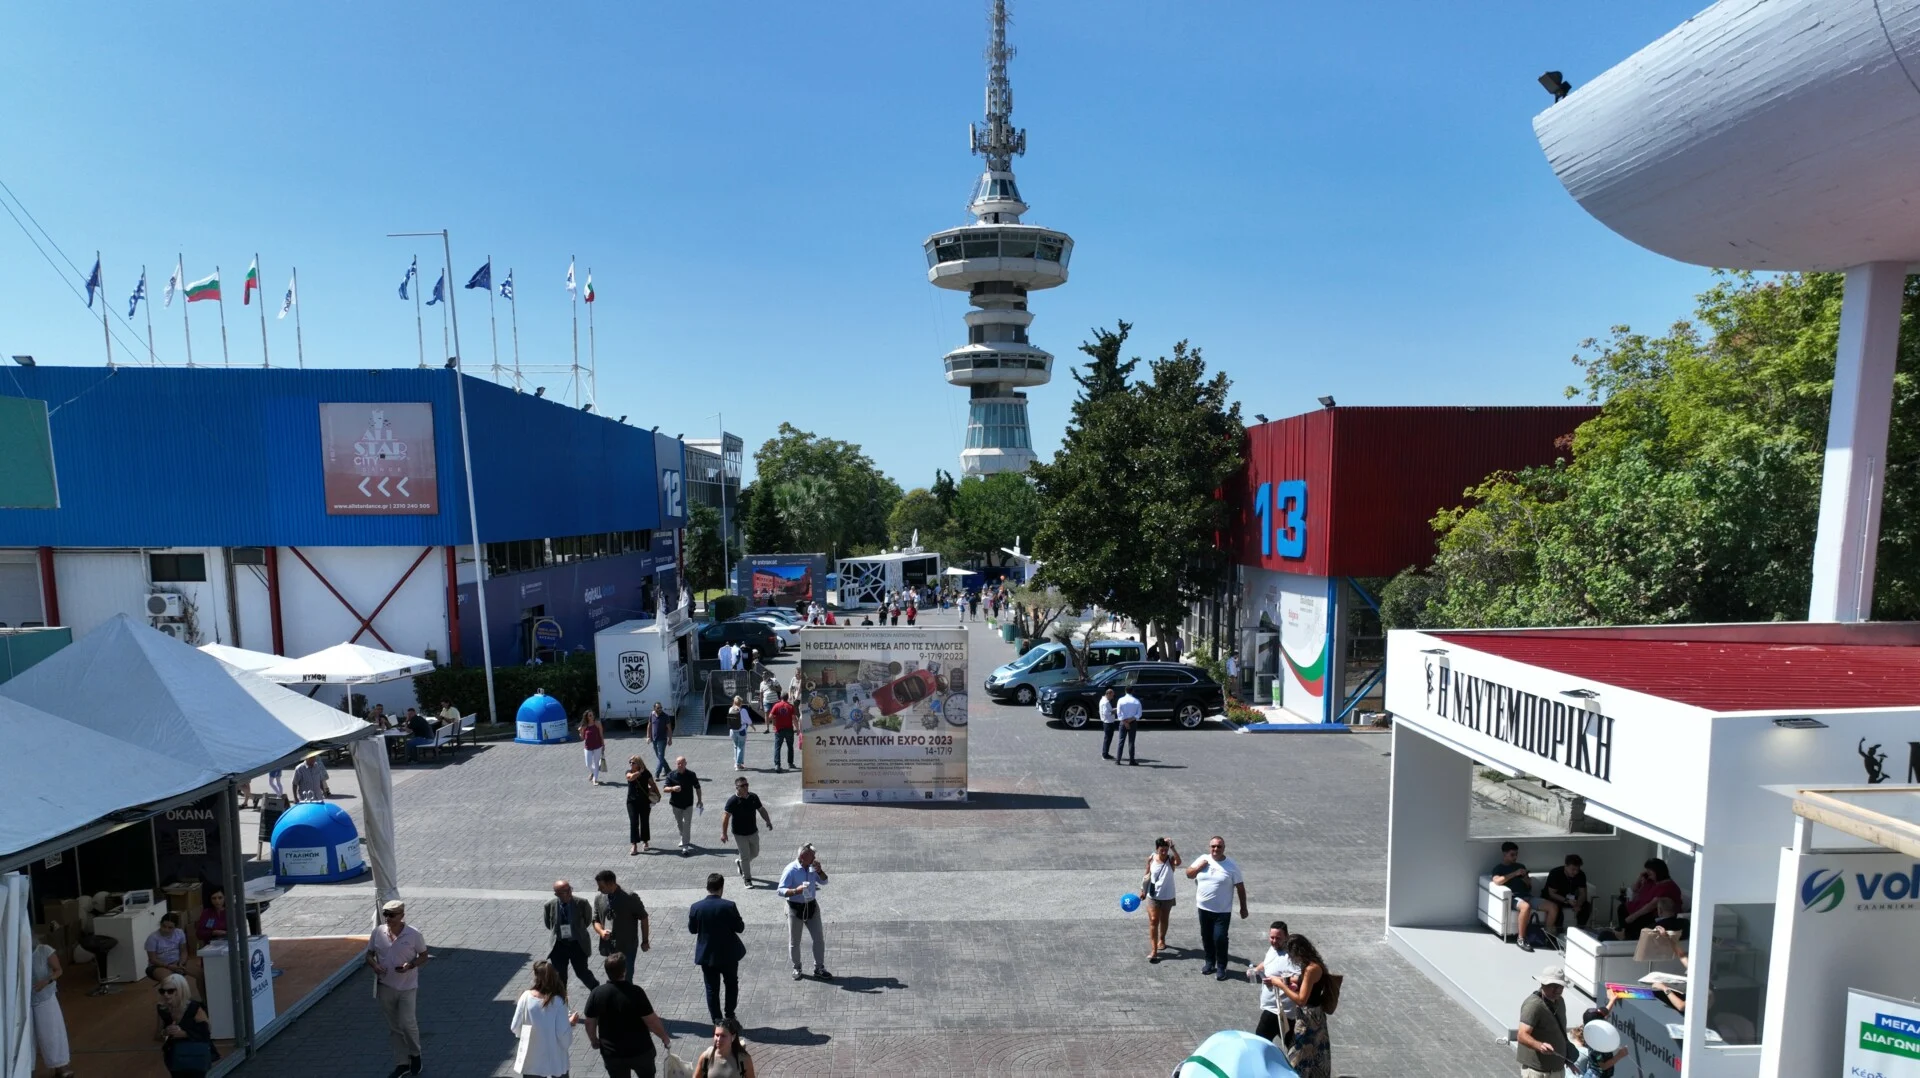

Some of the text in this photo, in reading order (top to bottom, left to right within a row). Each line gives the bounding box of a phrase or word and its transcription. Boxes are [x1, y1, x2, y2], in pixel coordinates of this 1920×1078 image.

[361, 430, 398, 441] ALL
[354, 442, 408, 460] STAR
[353, 457, 379, 466] CITY
[663, 471, 682, 517] 12
[1254, 479, 1307, 559] 13
[813, 643, 868, 651] ΘΕΣΣΑΛΟΝΙΚΗ
[870, 643, 891, 651] ΜΕΣΑ
[893, 643, 911, 651] ΑΠΟ
[912, 643, 924, 651] ΤΙΣ
[925, 643, 964, 651] ΣΥΛΛΟΓΕΣ
[621, 655, 645, 664] ΠΑΟΚ
[1437, 665, 1616, 784] Η ΝΑΥΤΕΜΠΟΡΙΚΗ
[815, 735, 953, 747] 2η ΣΥΛΛΕΚΤΙΚΗ EXPO 2023
[1857, 903, 1914, 911] ΕΛΛΗΝΙΚΗ
